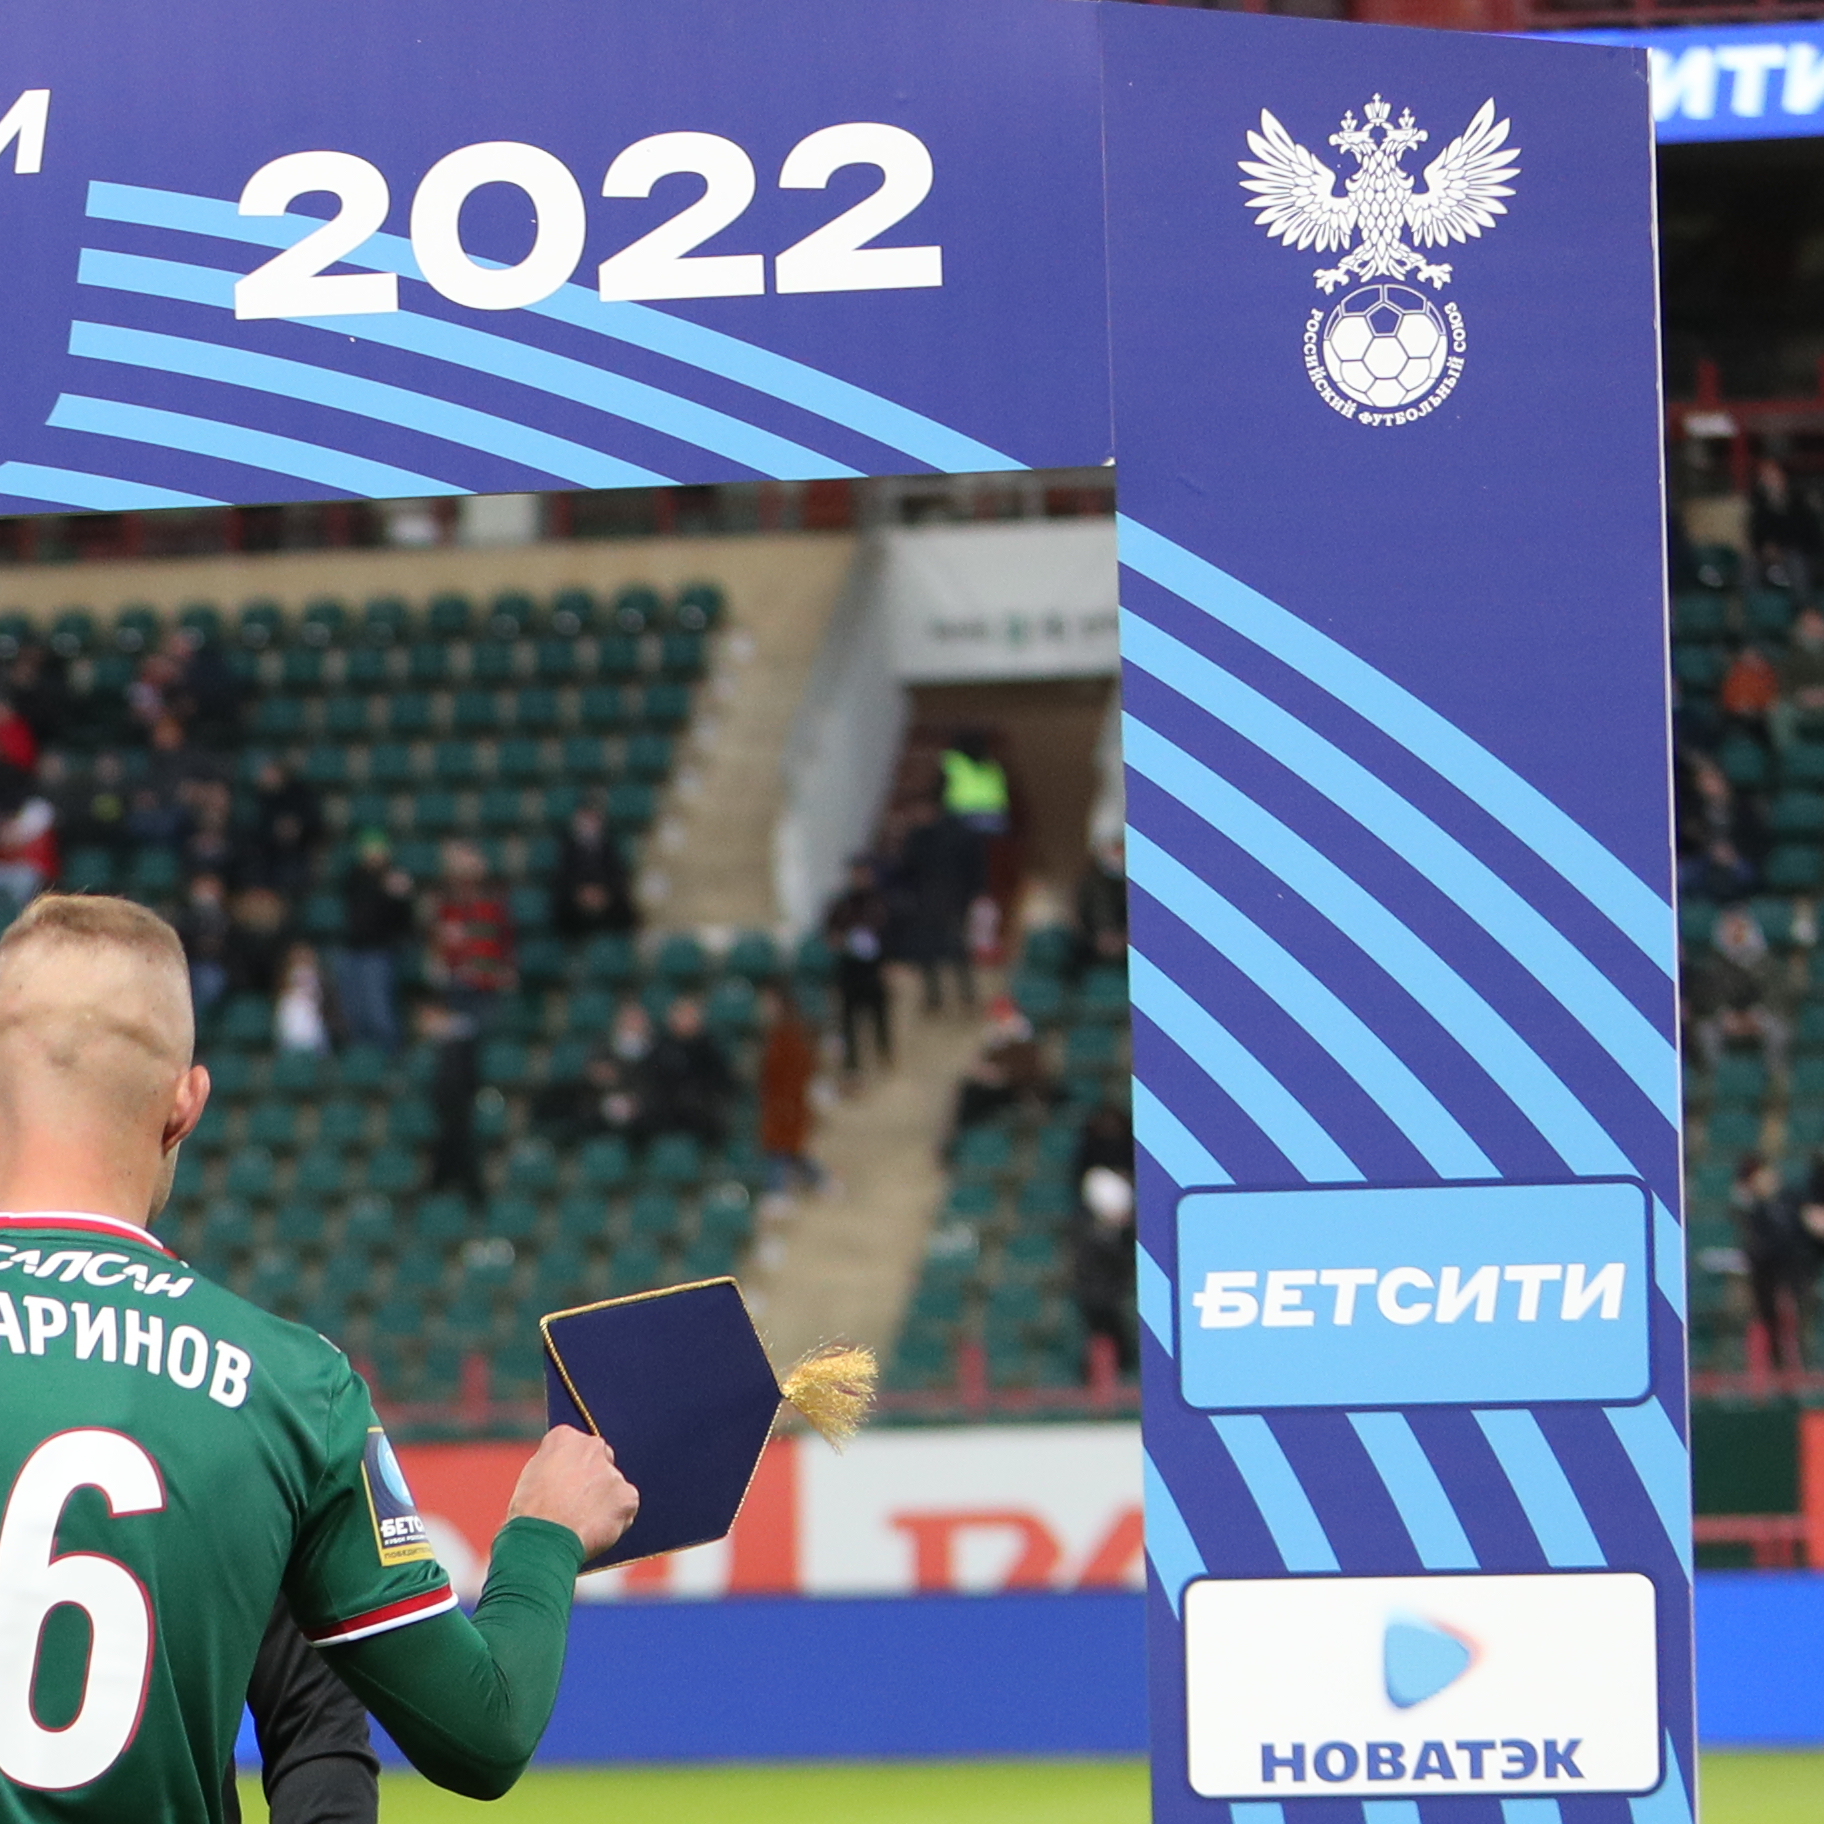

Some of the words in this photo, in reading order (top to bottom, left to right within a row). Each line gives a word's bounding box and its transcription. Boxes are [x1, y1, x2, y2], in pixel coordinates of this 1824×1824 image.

[1652, 42, 1824, 122] ИТИ
[233, 121, 943, 320] 2022
[1303, 308, 1357, 419] РОССИЙСКИЙ
[1358, 356, 1465, 427] ФУТБОЛЬНЫЙ
[1444, 302, 1467, 353] СОЮЗ
[1193, 1263, 1625, 1329] БЕТСИТИ
[380, 1515, 425, 1538] БЕТС
[1260, 1738, 1584, 1783] НОВАТЭК
